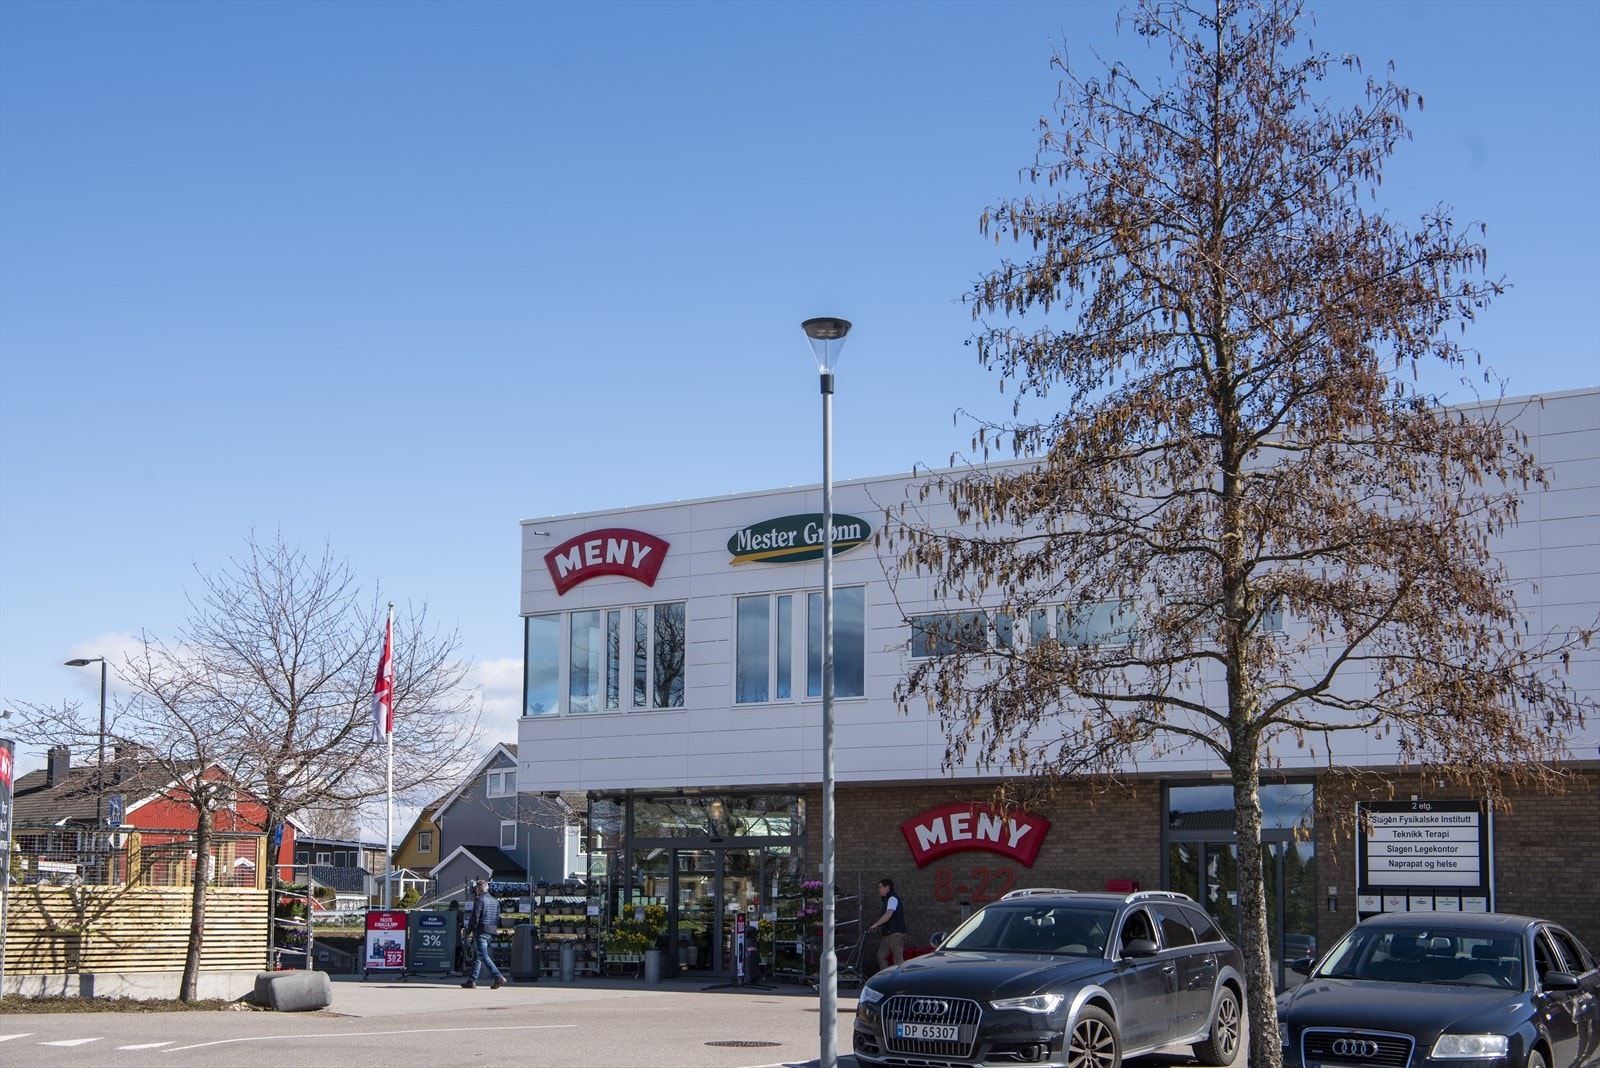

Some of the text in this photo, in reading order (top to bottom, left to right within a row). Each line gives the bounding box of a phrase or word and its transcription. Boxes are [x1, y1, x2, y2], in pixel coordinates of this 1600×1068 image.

[736, 527, 797, 552] Mester
[554, 538, 653, 579] MENY
[1411, 802, 1433, 811] 2 etg.
[1372, 815, 1472, 826] Slagen Fysikalske Institutt
[914, 812, 1032, 852] MENY
[1392, 830, 1450, 839] Teknikk Terapi
[1386, 845, 1459, 854] Slagen Legekontor
[1388, 859, 1458, 870] Naprapat og helse
[933, 866, 1016, 902] 8-22
[422, 934, 442, 946] 3%
[904, 1025, 956, 1039] DP 65307
